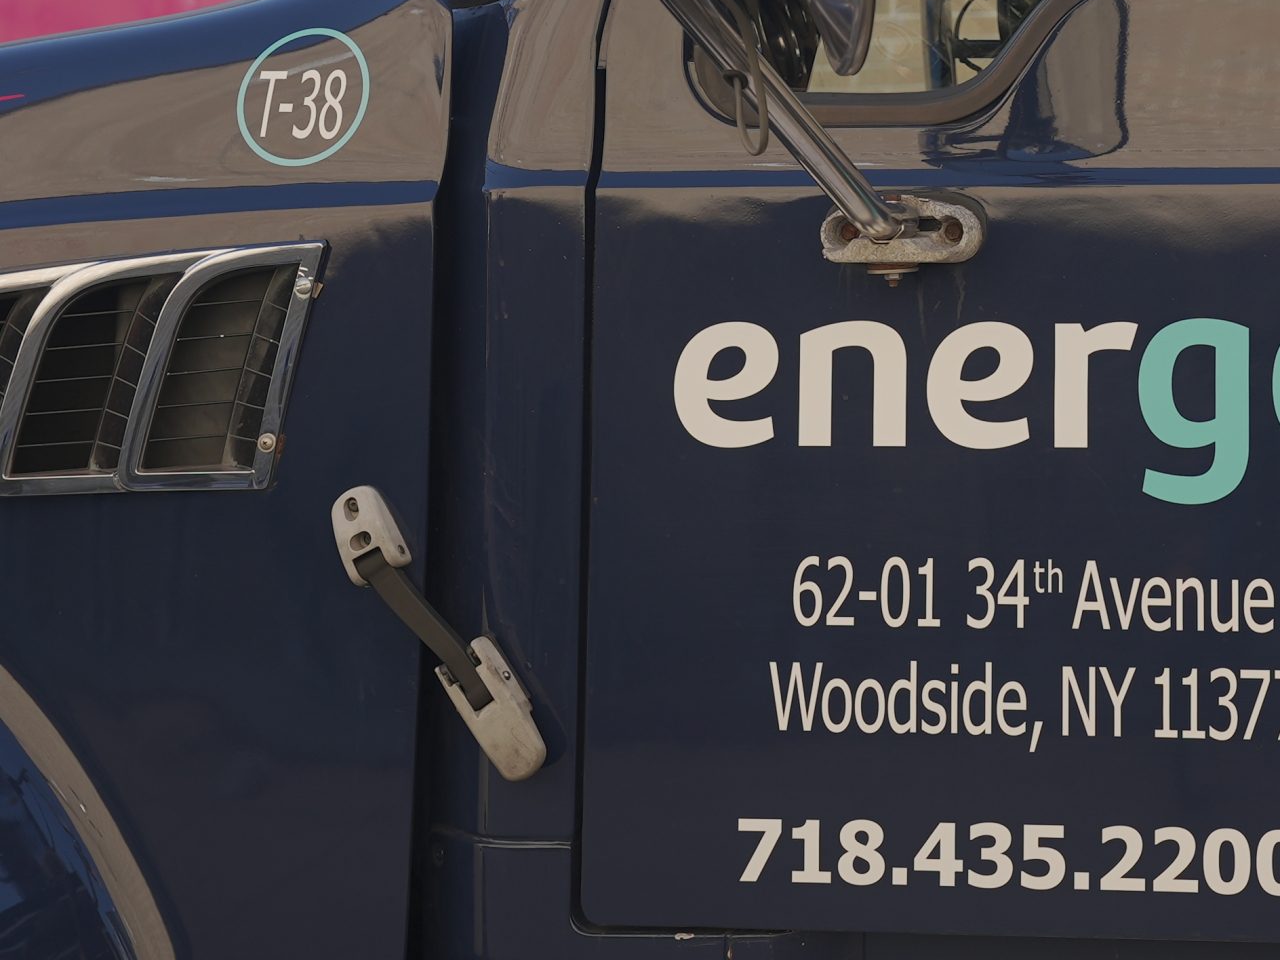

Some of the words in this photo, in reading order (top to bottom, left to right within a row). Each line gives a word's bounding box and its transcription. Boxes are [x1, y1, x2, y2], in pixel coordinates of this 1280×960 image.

[259, 69, 347, 140] T-38
[793, 556, 941, 628] 62-01
[966, 558, 1063, 630] 34th
[1071, 560, 1275, 634] Avenue
[769, 660, 1044, 753] Woodside,
[1061, 666, 1137, 737] NY
